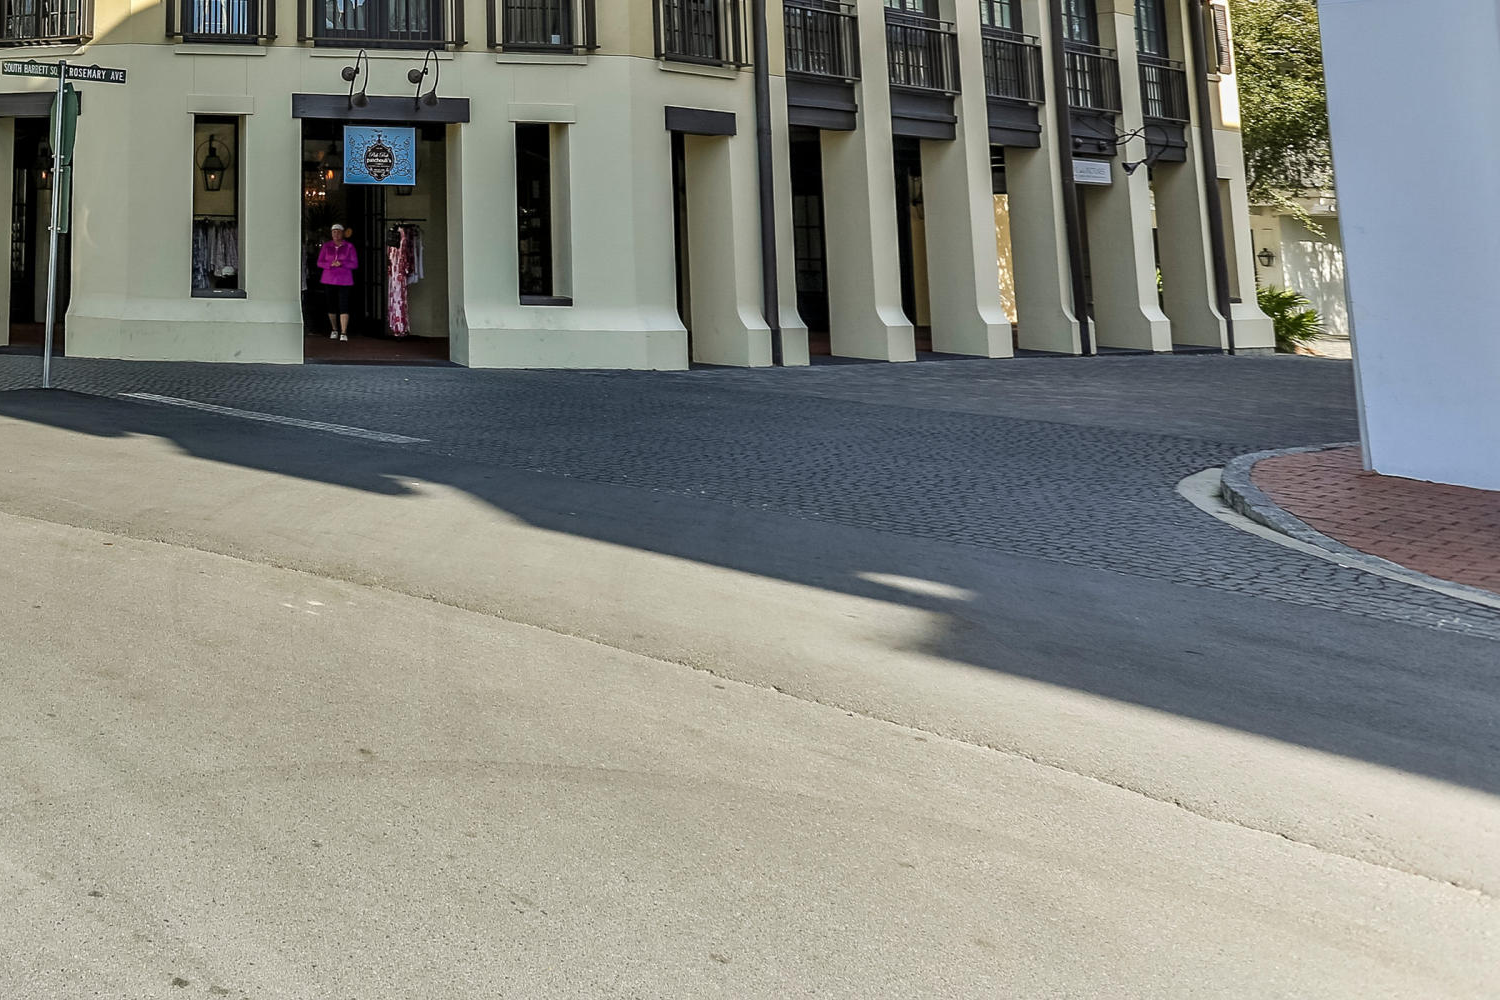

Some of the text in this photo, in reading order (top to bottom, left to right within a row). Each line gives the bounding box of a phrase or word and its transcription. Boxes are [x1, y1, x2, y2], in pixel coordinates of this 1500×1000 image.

[3, 62, 22, 73] SOUTH
[24, 64, 48, 75] BARRETT
[69, 67, 107, 80] ROSEMARY
